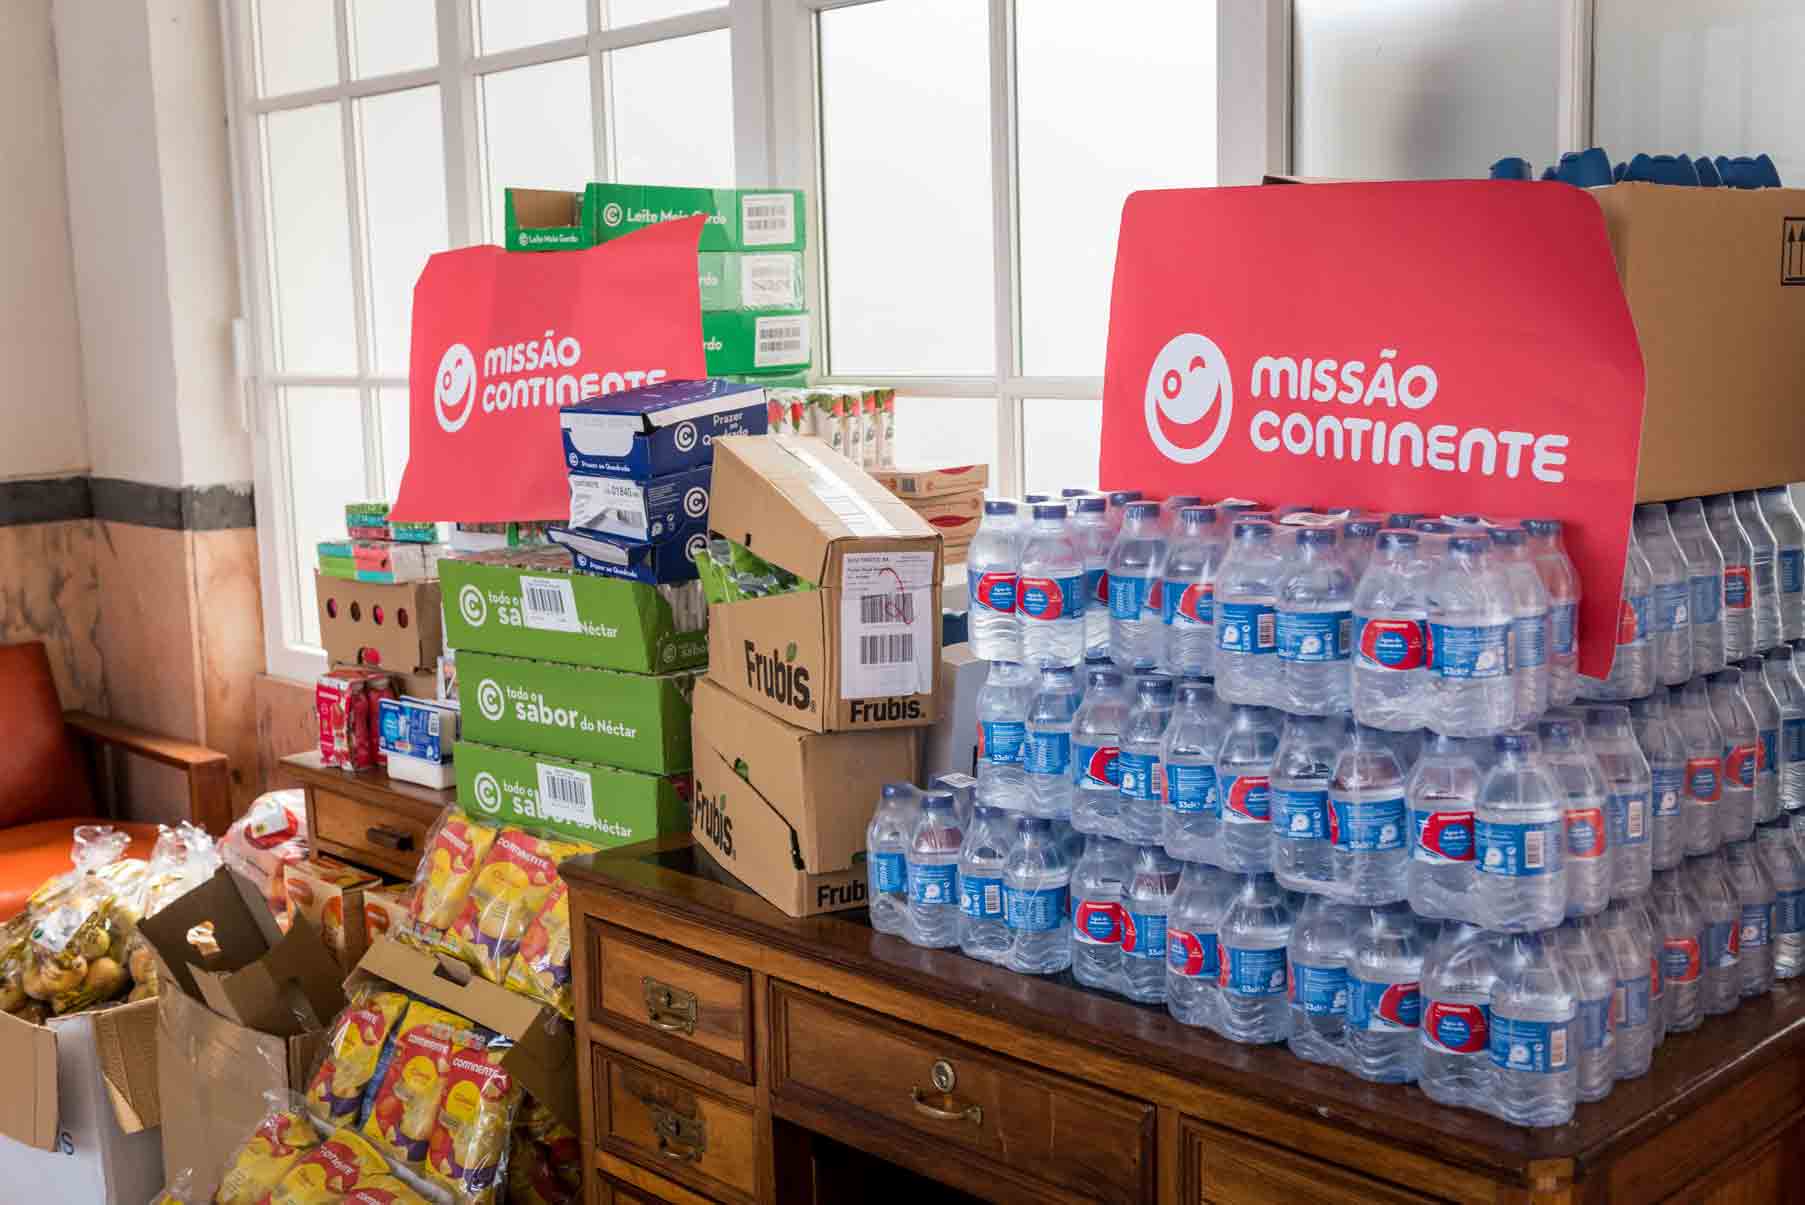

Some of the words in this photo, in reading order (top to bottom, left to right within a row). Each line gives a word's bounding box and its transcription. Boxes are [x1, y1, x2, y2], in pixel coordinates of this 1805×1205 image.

[627, 207, 657, 223] Leite
[483, 330, 582, 378] MISSÃO
[1250, 348, 1439, 410] MISSÃO
[1249, 410, 1570, 484] CONTINENTE
[488, 590, 511, 605] todo
[512, 597, 519, 605] o
[506, 685, 529, 701] todo
[530, 693, 537, 701] o
[744, 640, 810, 711] Frubis
[515, 694, 578, 729] sabor
[580, 717, 594, 732] do
[597, 719, 637, 738] Néctar
[503, 779, 526, 795] todo
[527, 787, 534, 796] o
[695, 780, 733, 857] Frubis
[817, 880, 865, 908] Frub
